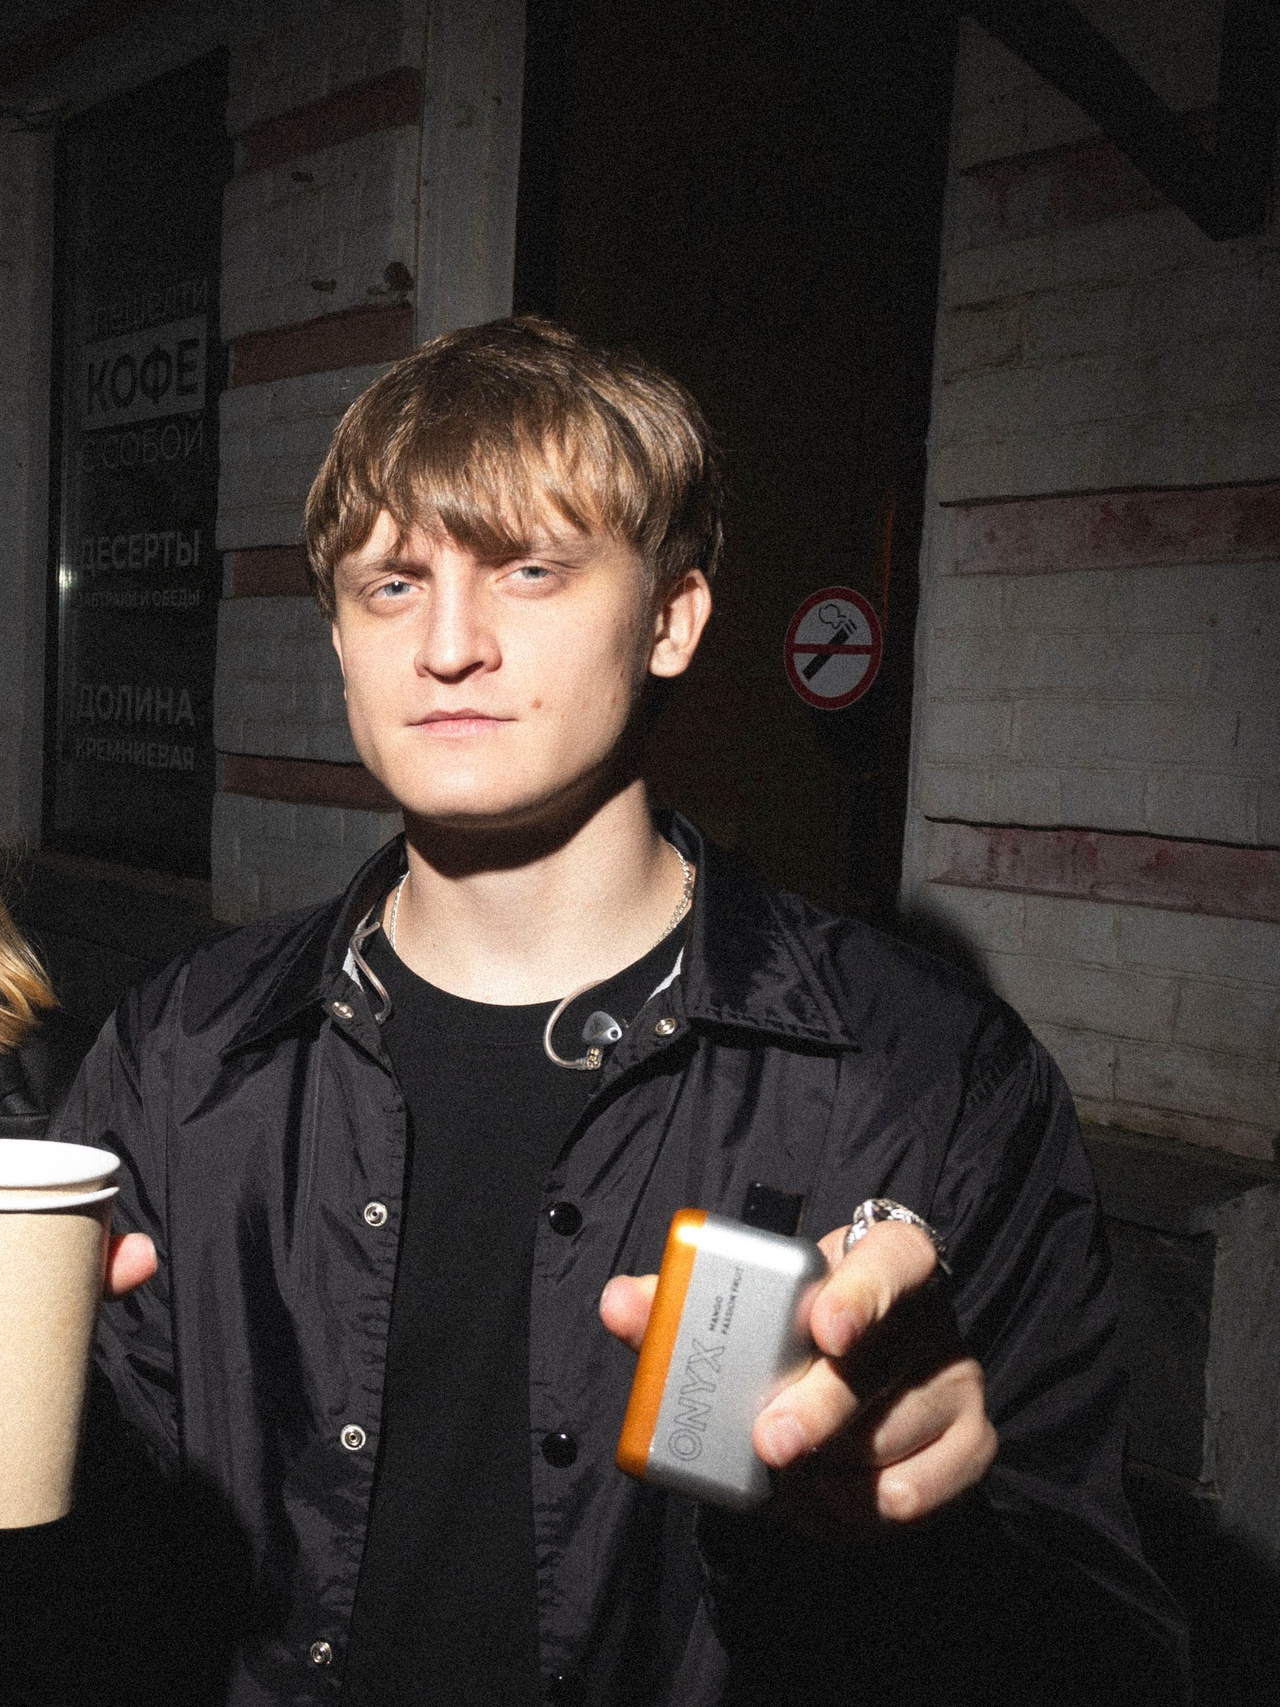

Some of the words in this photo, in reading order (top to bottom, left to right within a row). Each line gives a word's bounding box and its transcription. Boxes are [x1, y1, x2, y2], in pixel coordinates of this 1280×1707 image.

[87, 338, 200, 415] КОФЕ
[102, 411, 203, 469] СОБОЙ
[79, 529, 199, 578] ДЕСЕРТЫ
[77, 683, 195, 727] ДОЛИНА
[709, 1295, 724, 1331] MANGO
[669, 1337, 725, 1461] ONYX
